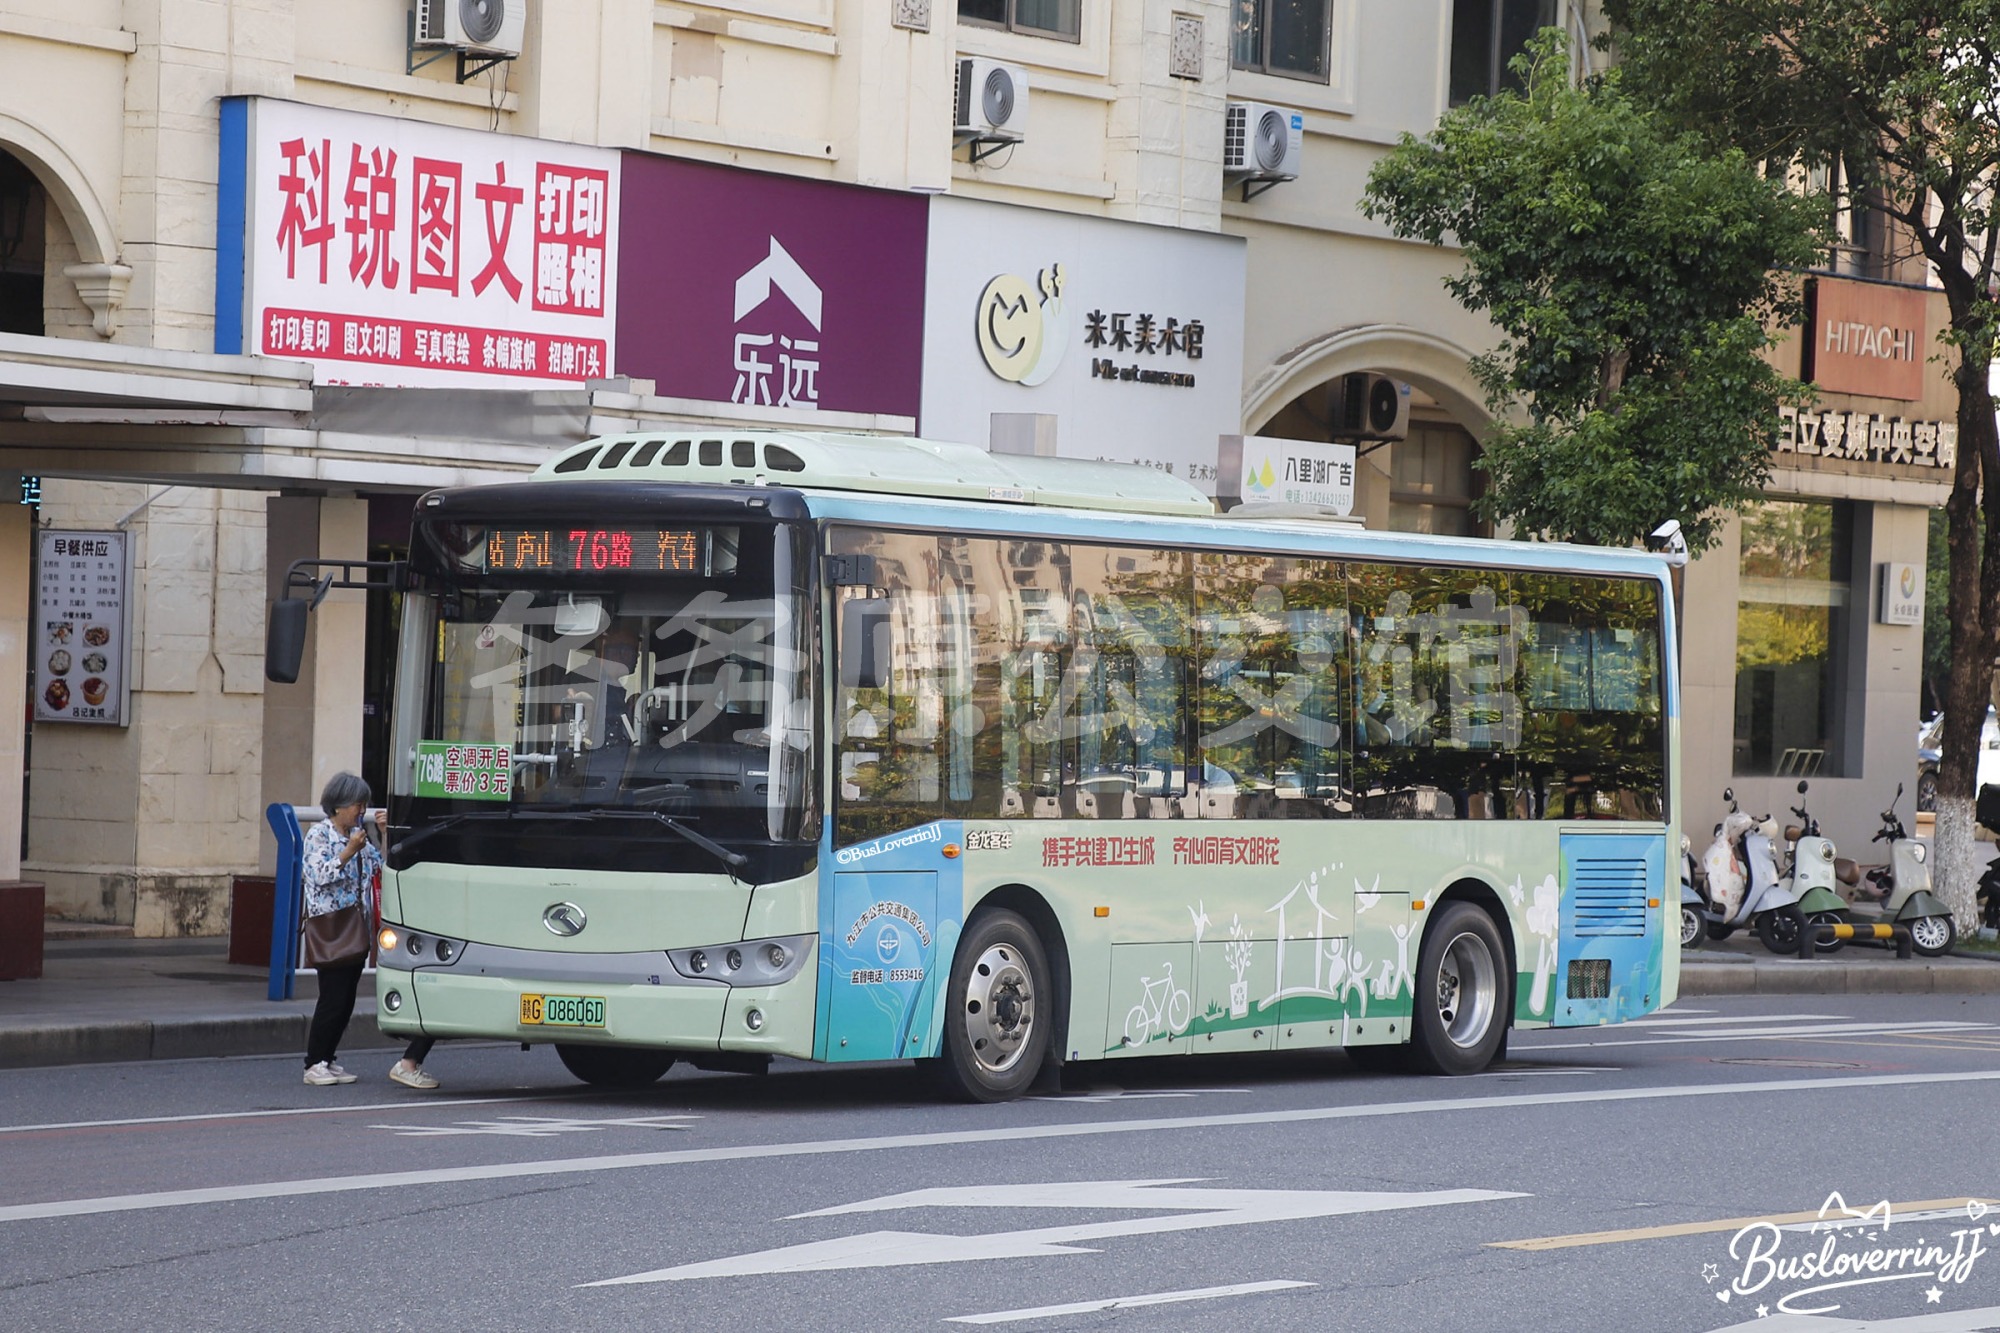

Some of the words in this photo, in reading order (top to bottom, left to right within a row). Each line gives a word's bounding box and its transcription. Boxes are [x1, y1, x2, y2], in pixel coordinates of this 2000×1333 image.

[276, 137, 524, 304] 科锐图文
[539, 171, 604, 239] 打印
[536, 242, 602, 309] 照相
[270, 314, 330, 352] 打印复印
[344, 322, 401, 359] 图文印刷
[414, 328, 470, 366] 写真喷绘
[482, 336, 536, 371] 条幅旗帜
[548, 340, 600, 377] 招牌门头
[1084, 309, 1205, 359] 米乐美术馆
[1825, 319, 1915, 362] HITACHI
[731, 332, 820, 411] 乐远
[1777, 404, 1958, 469] 日立变频中央空调
[1285, 457, 1352, 486] 八里湖广告
[54, 539, 108, 556] 早餐供应
[569, 531, 633, 569] 76路
[657, 531, 697, 570] 汽车
[420, 753, 444, 784] 76路
[446, 747, 510, 769] 空调开启
[445, 771, 509, 794] 票价3元
[967, 830, 1012, 849] 金龙客车
[1042, 837, 1155, 867] 携手共建卫生城
[1173, 836, 1280, 865] 齐心同育文明花
[846, 900, 932, 949] 九江市公共交通集团公司
